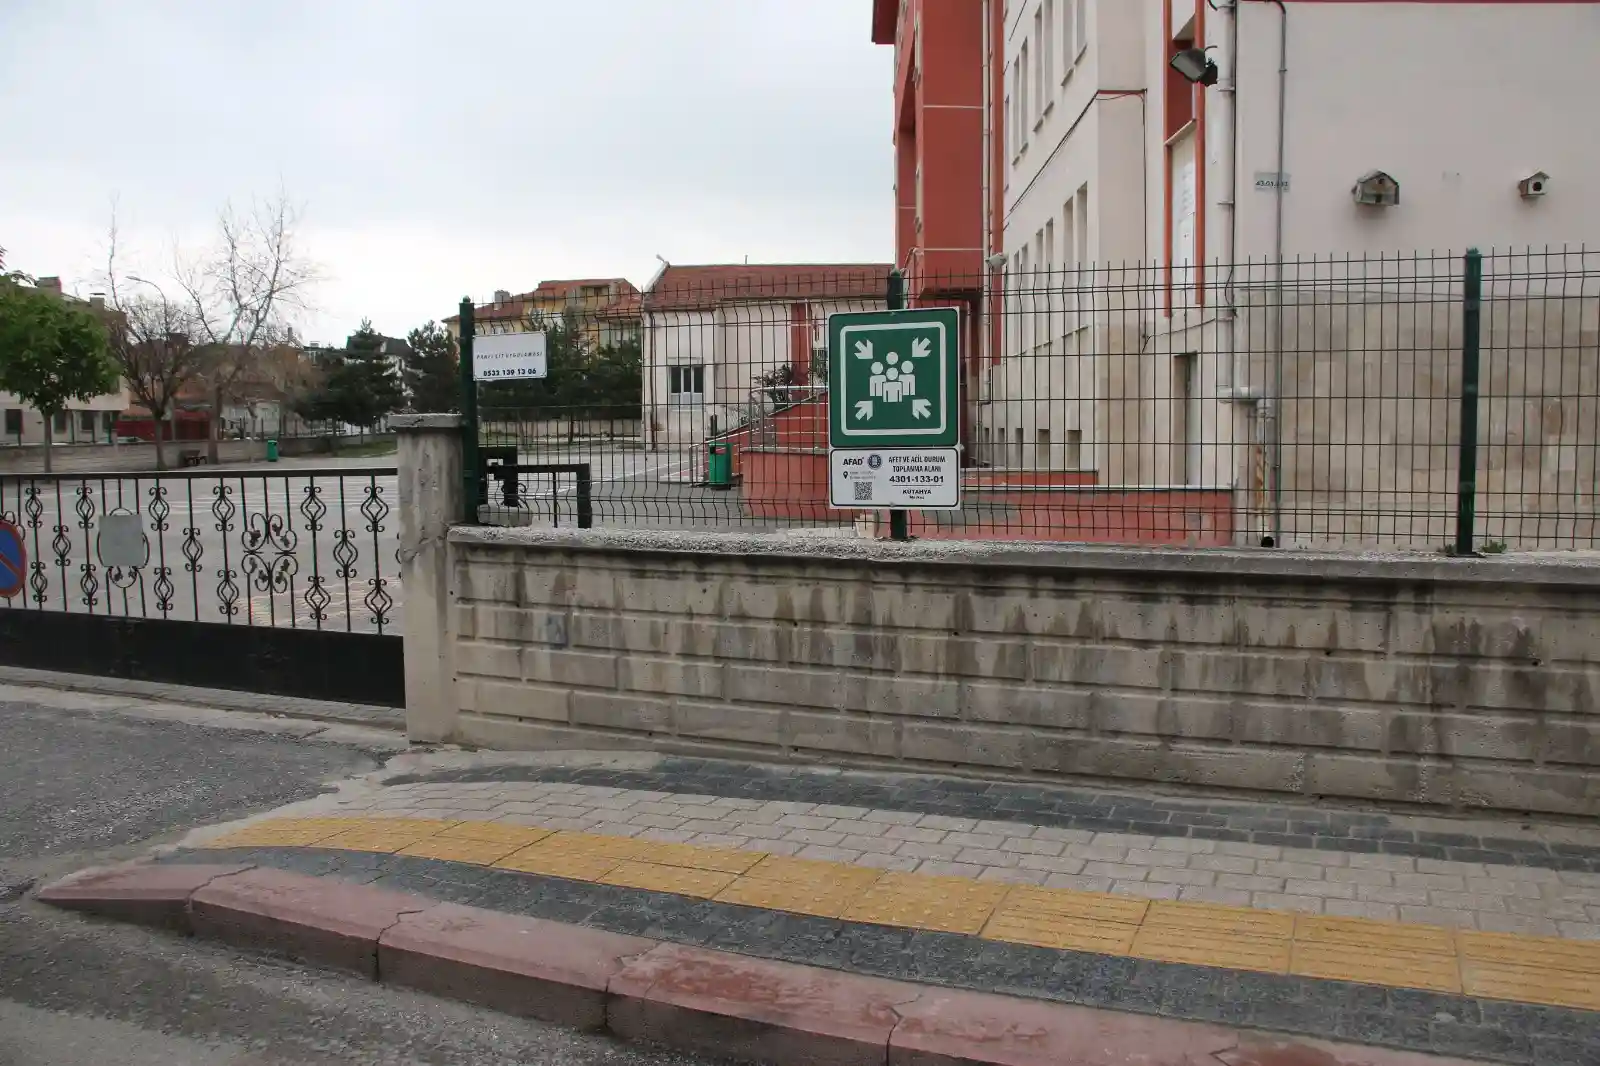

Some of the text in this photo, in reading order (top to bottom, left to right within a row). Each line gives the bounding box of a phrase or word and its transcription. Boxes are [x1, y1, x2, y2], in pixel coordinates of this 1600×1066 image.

[842, 458, 863, 466] AFAD
[924, 455, 946, 463] DURUM
[893, 465, 942, 473] TOPLANMA ALANI
[889, 475, 944, 483] 4301-133-01
